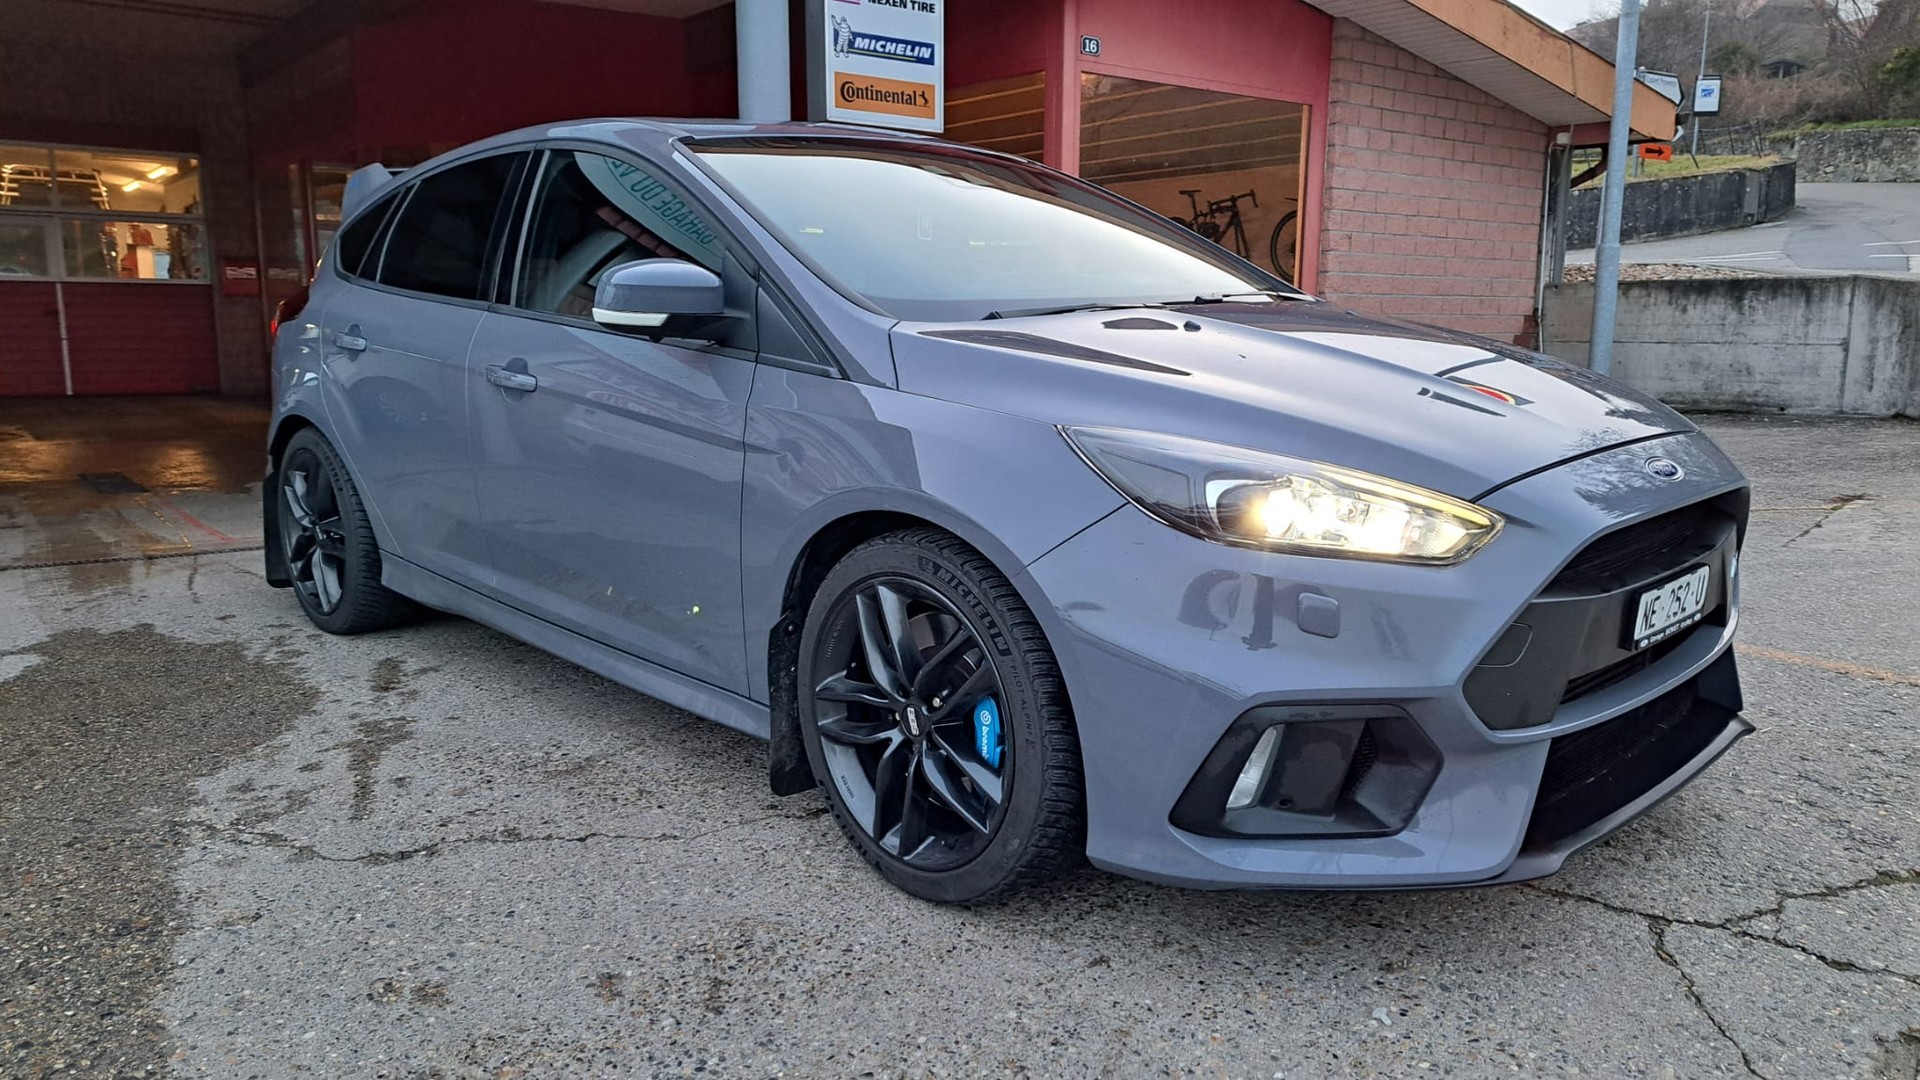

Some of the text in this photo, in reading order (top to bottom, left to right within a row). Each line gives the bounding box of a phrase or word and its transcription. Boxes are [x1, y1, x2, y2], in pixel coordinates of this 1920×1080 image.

[909, 1, 936, 14] TIRE
[854, 37, 932, 59] MICHELIN
[1085, 40, 1098, 53] 16
[840, 80, 917, 106] Continental
[937, 568, 1008, 650] MICHELIN
[1640, 595, 1661, 635] NE
[1666, 581, 1690, 619] 252
[1695, 574, 1706, 607] U
